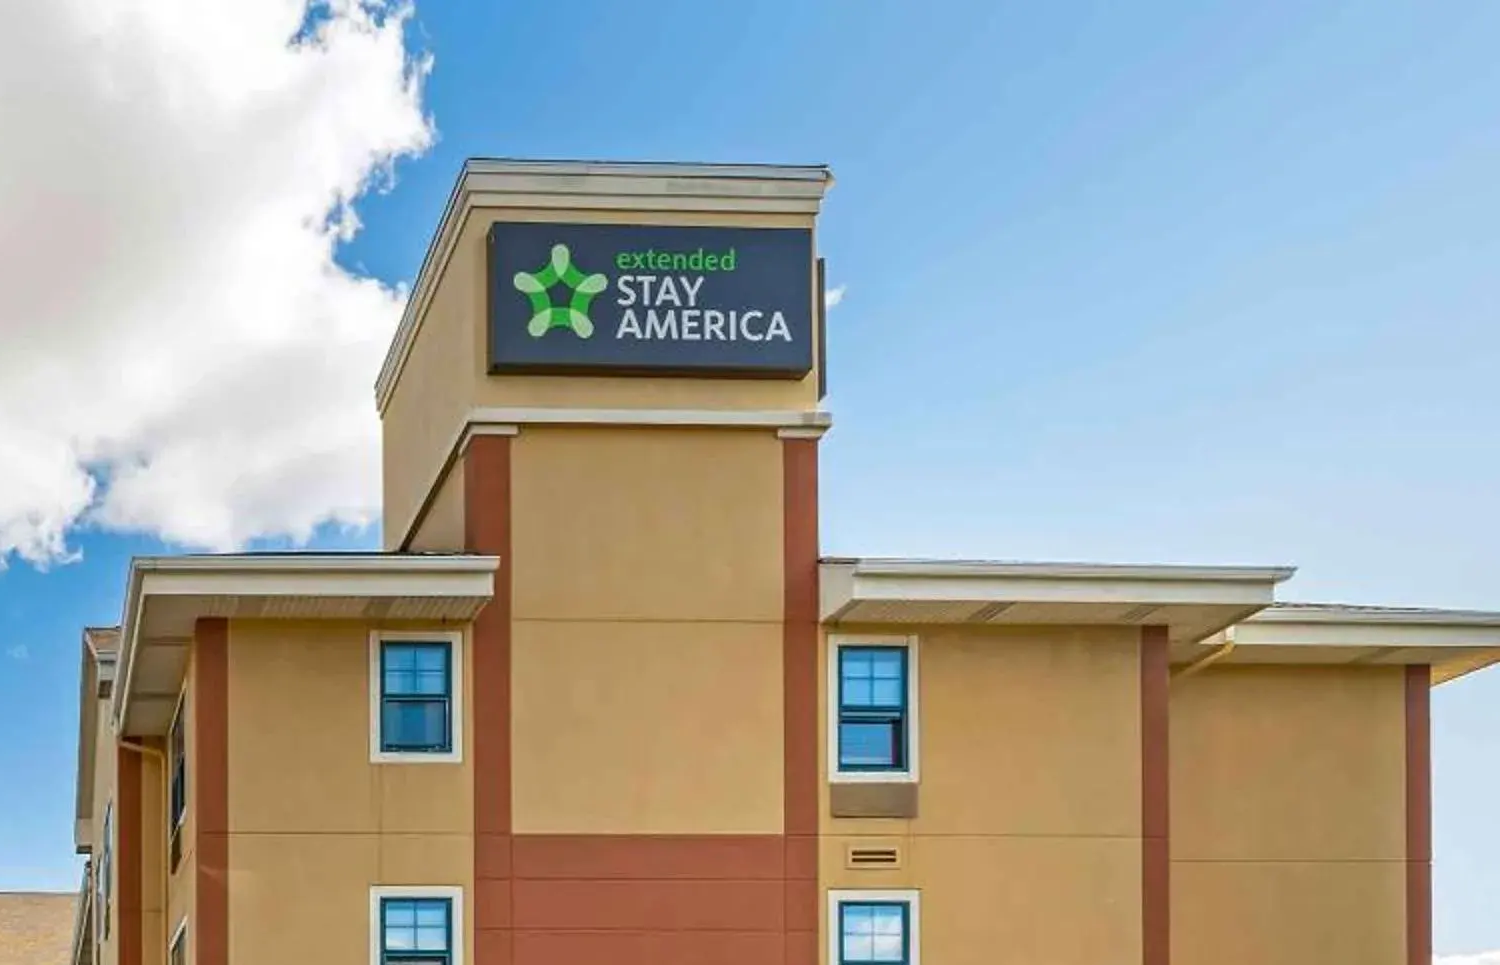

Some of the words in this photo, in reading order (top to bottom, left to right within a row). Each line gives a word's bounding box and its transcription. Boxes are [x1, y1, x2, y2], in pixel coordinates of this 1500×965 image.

[617, 249, 736, 271] extended
[617, 275, 704, 307] STAY
[617, 309, 792, 341] AMERICA
